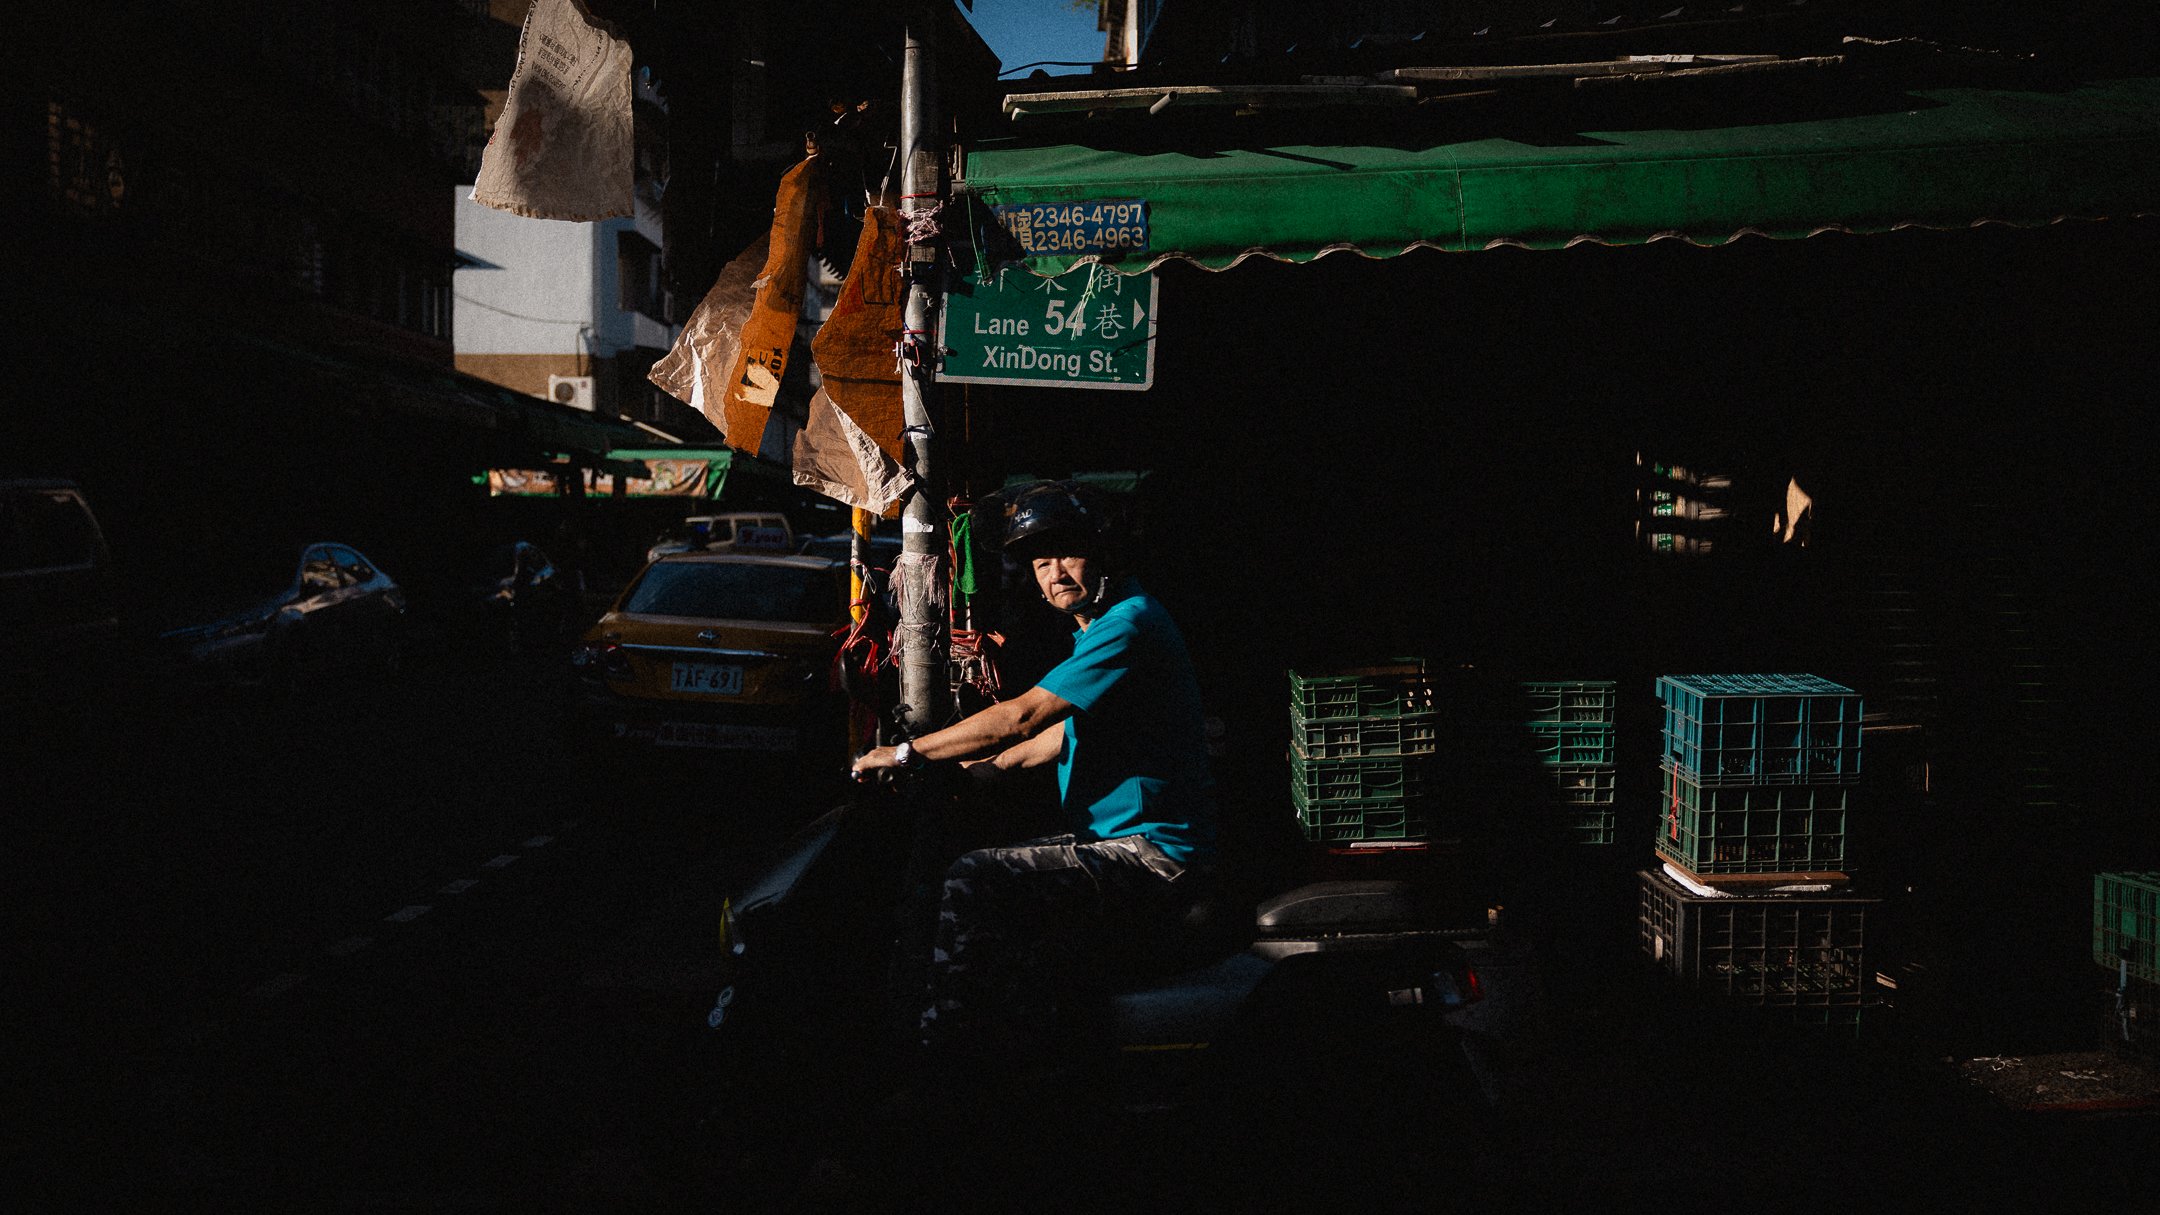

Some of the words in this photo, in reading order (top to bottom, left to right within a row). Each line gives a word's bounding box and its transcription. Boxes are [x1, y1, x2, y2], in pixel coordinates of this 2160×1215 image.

[1033, 203, 1142, 228] 2346-4797
[1034, 227, 1144, 251] 2346-4963
[974, 312, 1029, 336] Lane
[1044, 299, 1087, 337] 54
[1091, 302, 1126, 340] 巷
[982, 344, 1081, 377] XinDong
[1088, 349, 1118, 373] St.
[674, 667, 739, 690] TAF-691
